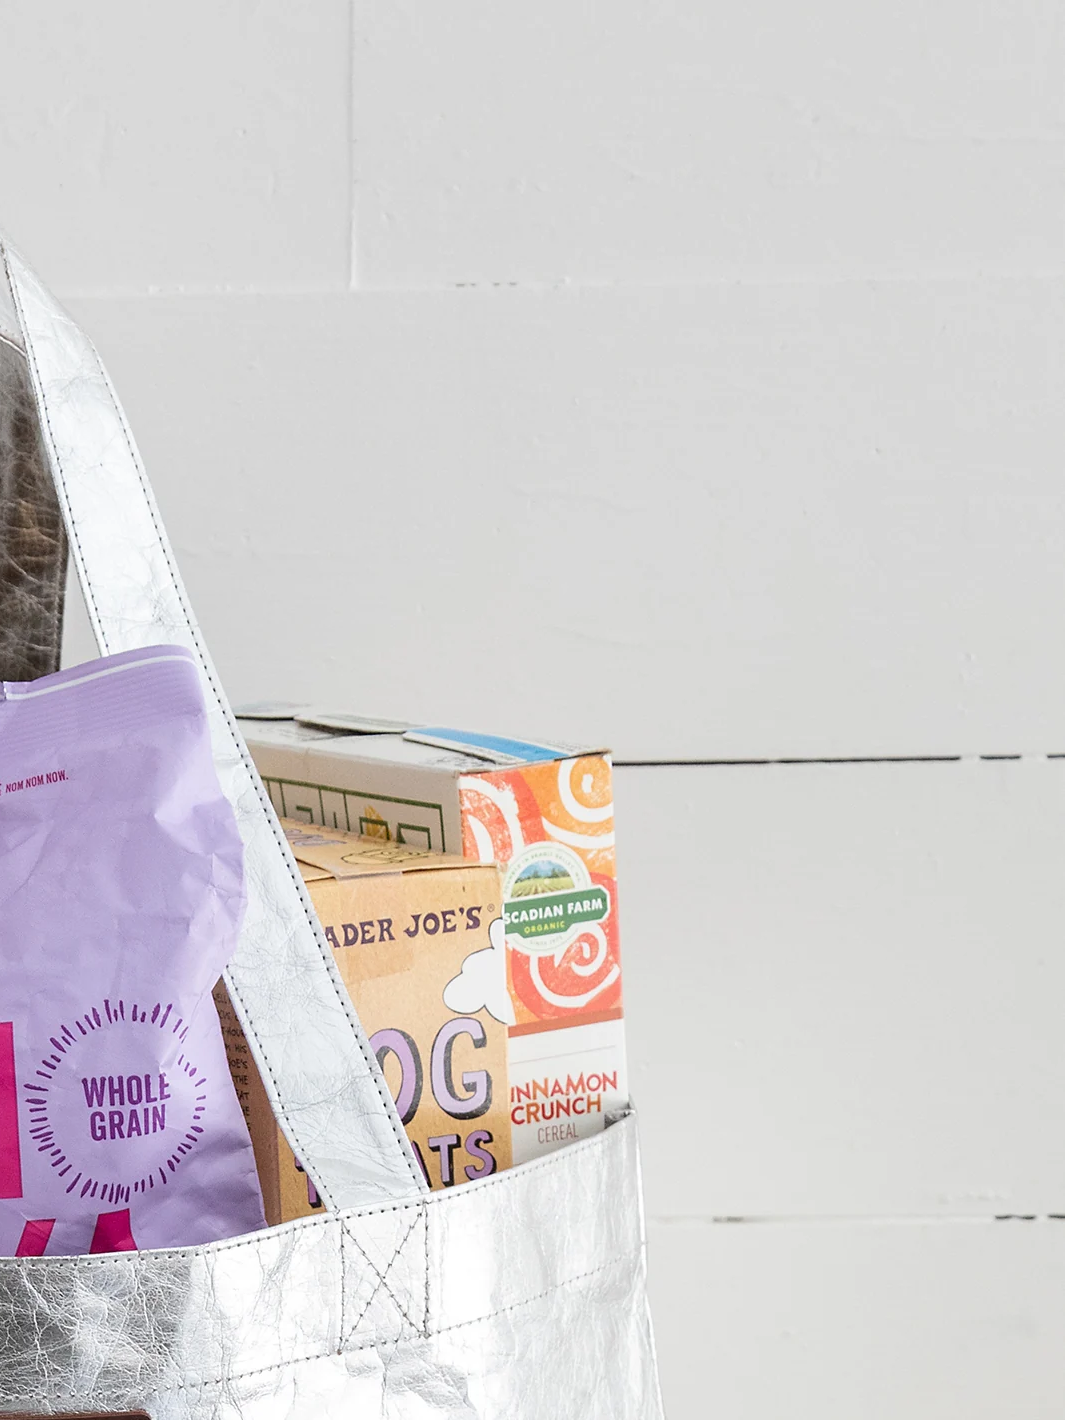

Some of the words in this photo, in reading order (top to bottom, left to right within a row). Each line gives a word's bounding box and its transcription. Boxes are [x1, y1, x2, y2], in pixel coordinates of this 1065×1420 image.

[4, 780, 24, 794] NOM
[25, 774, 44, 788] NOM
[46, 769, 69, 784] NOW.
[324, 918, 396, 949] ADER
[404, 905, 483, 938] JOE'S
[504, 904, 564, 925] SCADIAN
[567, 898, 603, 914] FARM
[524, 921, 566, 934] ORGANIC
[368, 1017, 493, 1127] OG
[511, 1070, 618, 1103] INNAMON
[82, 1073, 171, 1107] WHOLE
[90, 1106, 166, 1141] GRAIN
[511, 1095, 602, 1125] CRUNCH
[537, 1122, 579, 1145] CEREAL
